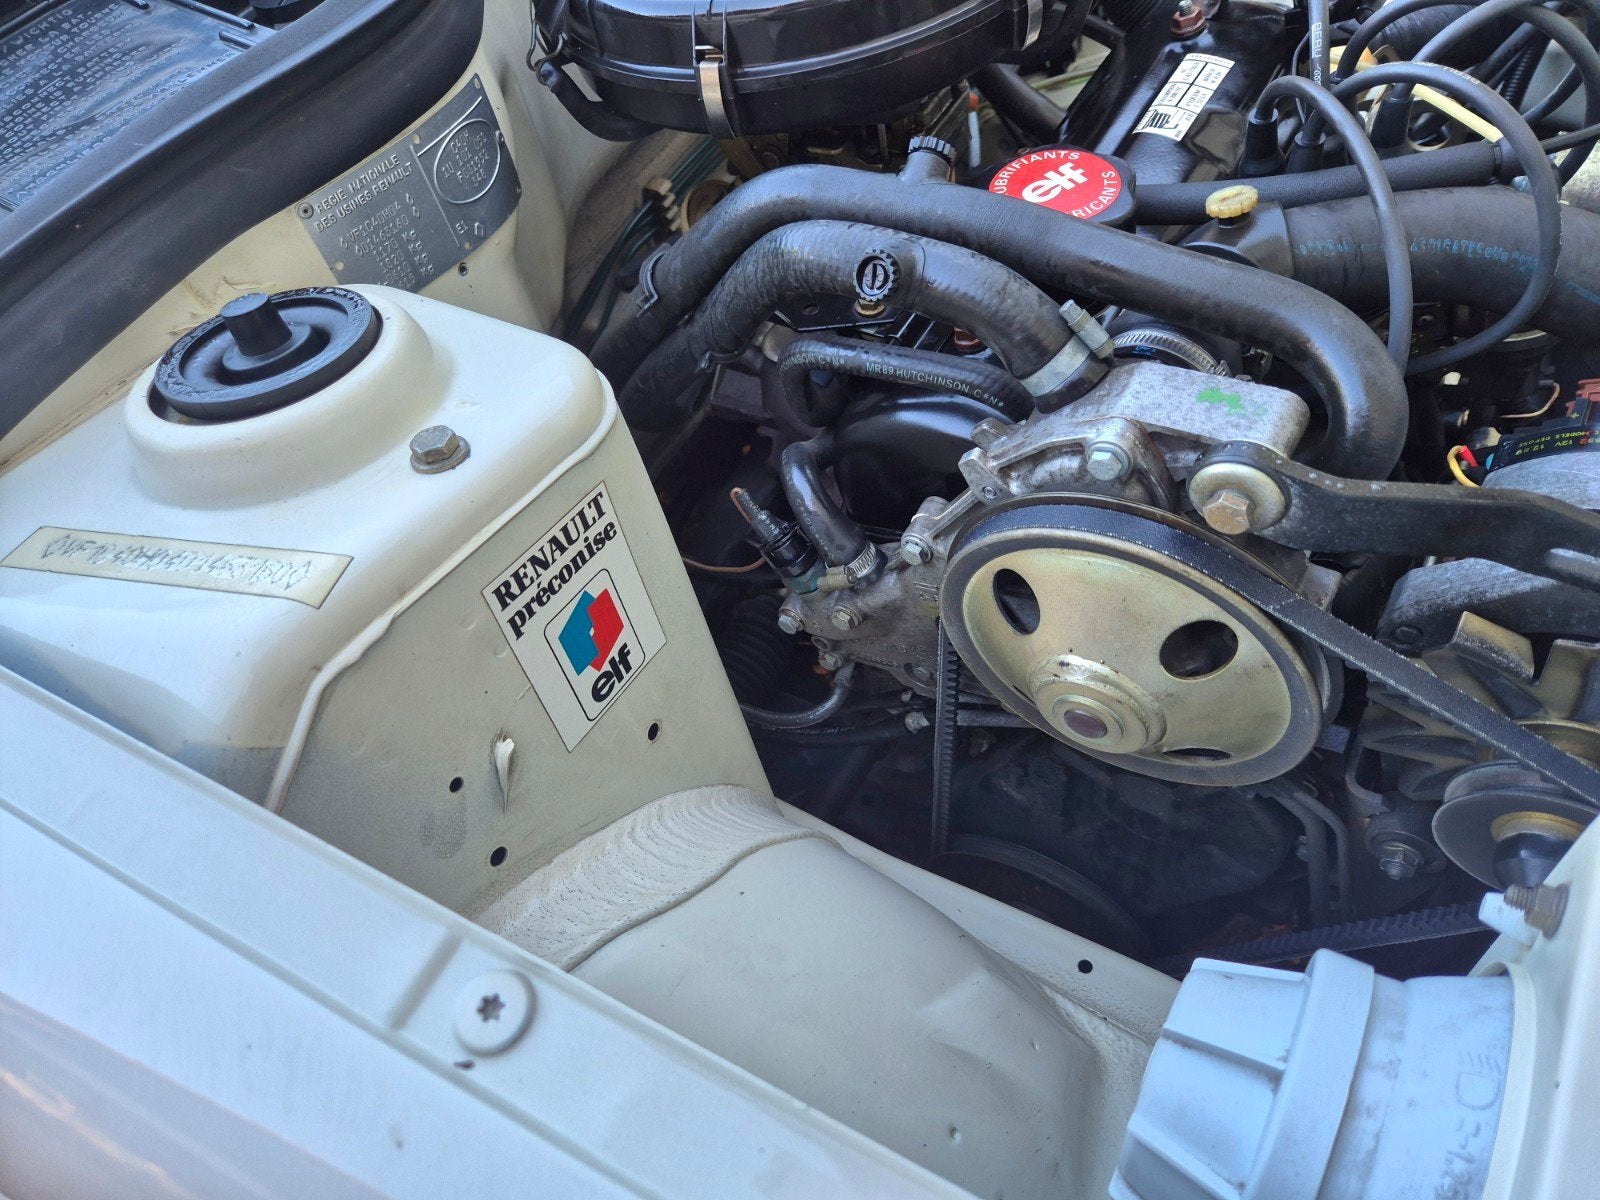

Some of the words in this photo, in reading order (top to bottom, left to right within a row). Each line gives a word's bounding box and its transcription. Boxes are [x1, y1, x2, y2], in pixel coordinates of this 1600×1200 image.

[8, 8, 73, 46] WICHTIG
[1311, 21, 1324, 59] BERU
[314, 214, 338, 233] DES
[336, 190, 373, 218] USINES
[373, 161, 414, 196] RENAULT
[315, 189, 347, 214] REGIE
[348, 153, 401, 193] NATIONALE
[1021, 161, 1090, 204] elf
[1066, 168, 1117, 218] RICANTS
[895, 367, 970, 394] HUTCHINSON
[491, 491, 608, 612] RENAULT
[506, 520, 618, 642] préconise
[591, 642, 633, 703] elf
